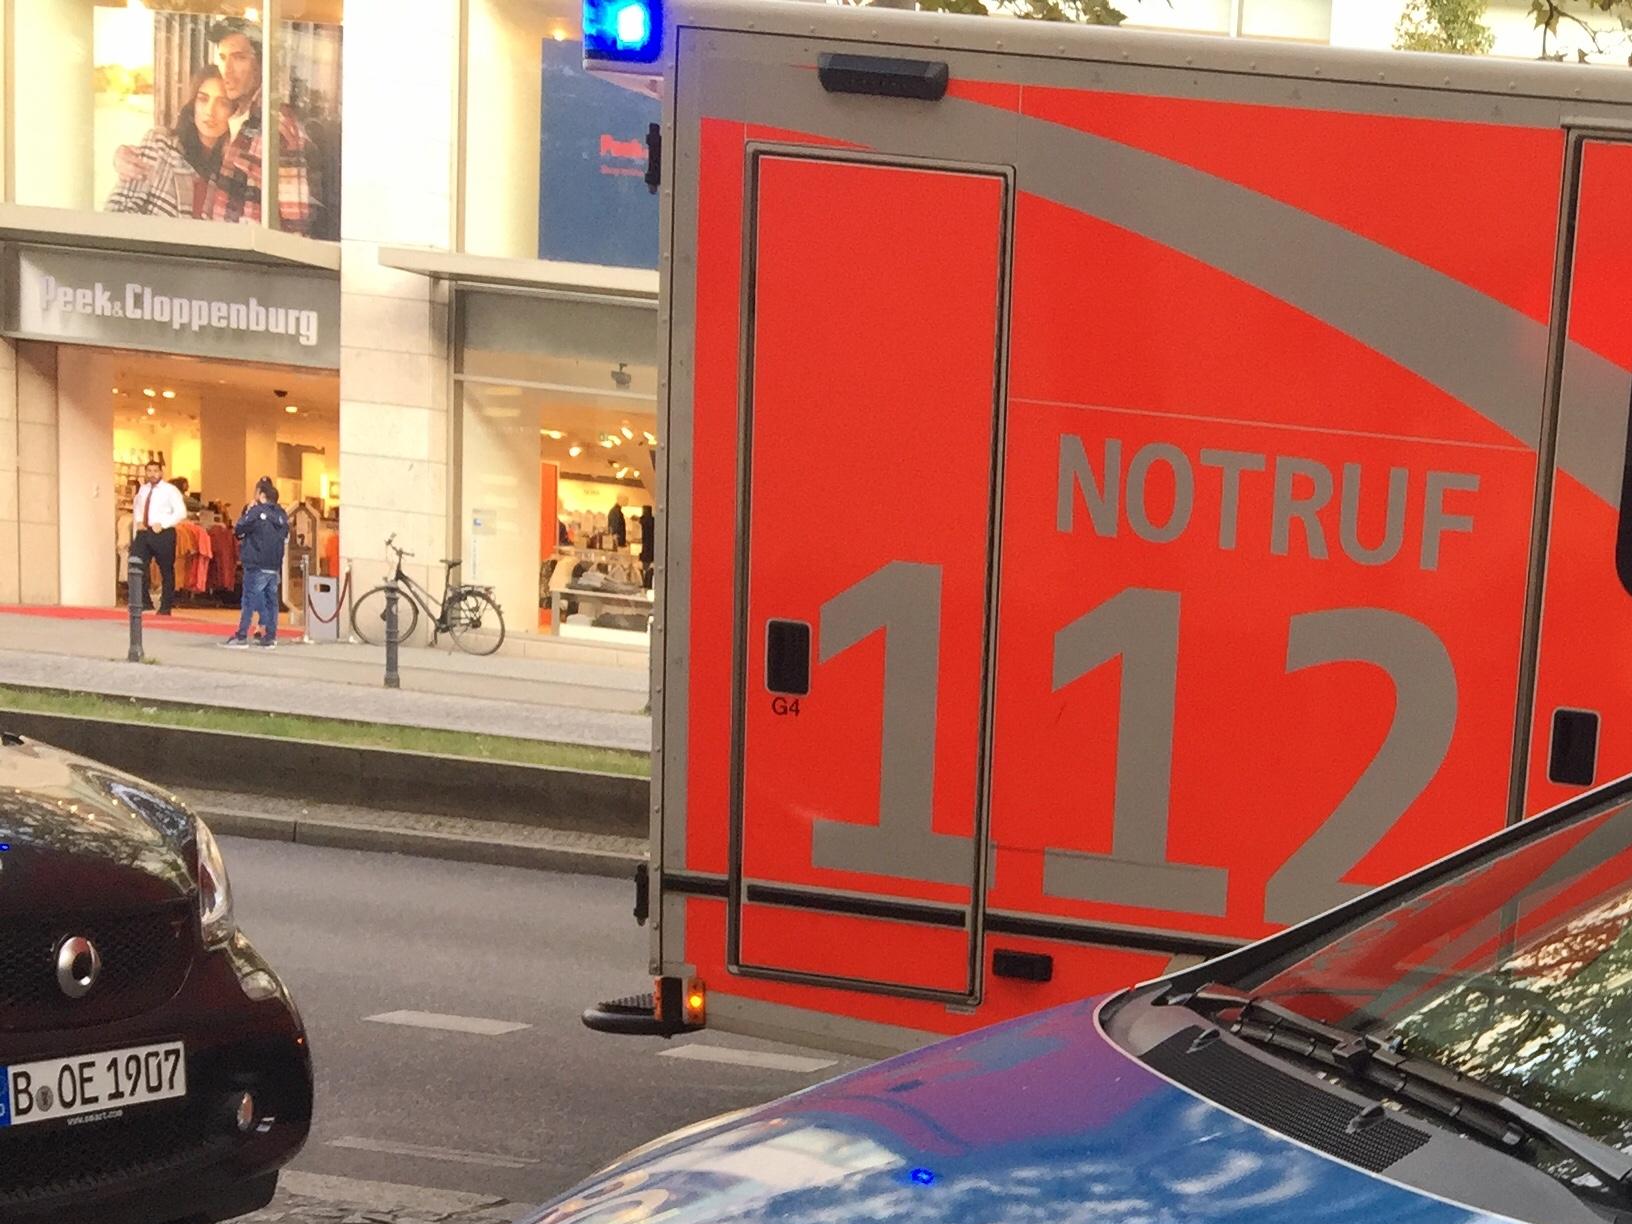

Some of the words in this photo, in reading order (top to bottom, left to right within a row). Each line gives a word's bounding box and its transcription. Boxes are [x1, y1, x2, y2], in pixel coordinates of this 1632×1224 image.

[39, 275, 112, 317] Peek
[124, 283, 318, 346] Cloppenburg
[1056, 433, 1482, 572] NOTRUF
[772, 697, 800, 717] G4
[811, 559, 1460, 926] 112
[106, 1049, 181, 1101] 1907
